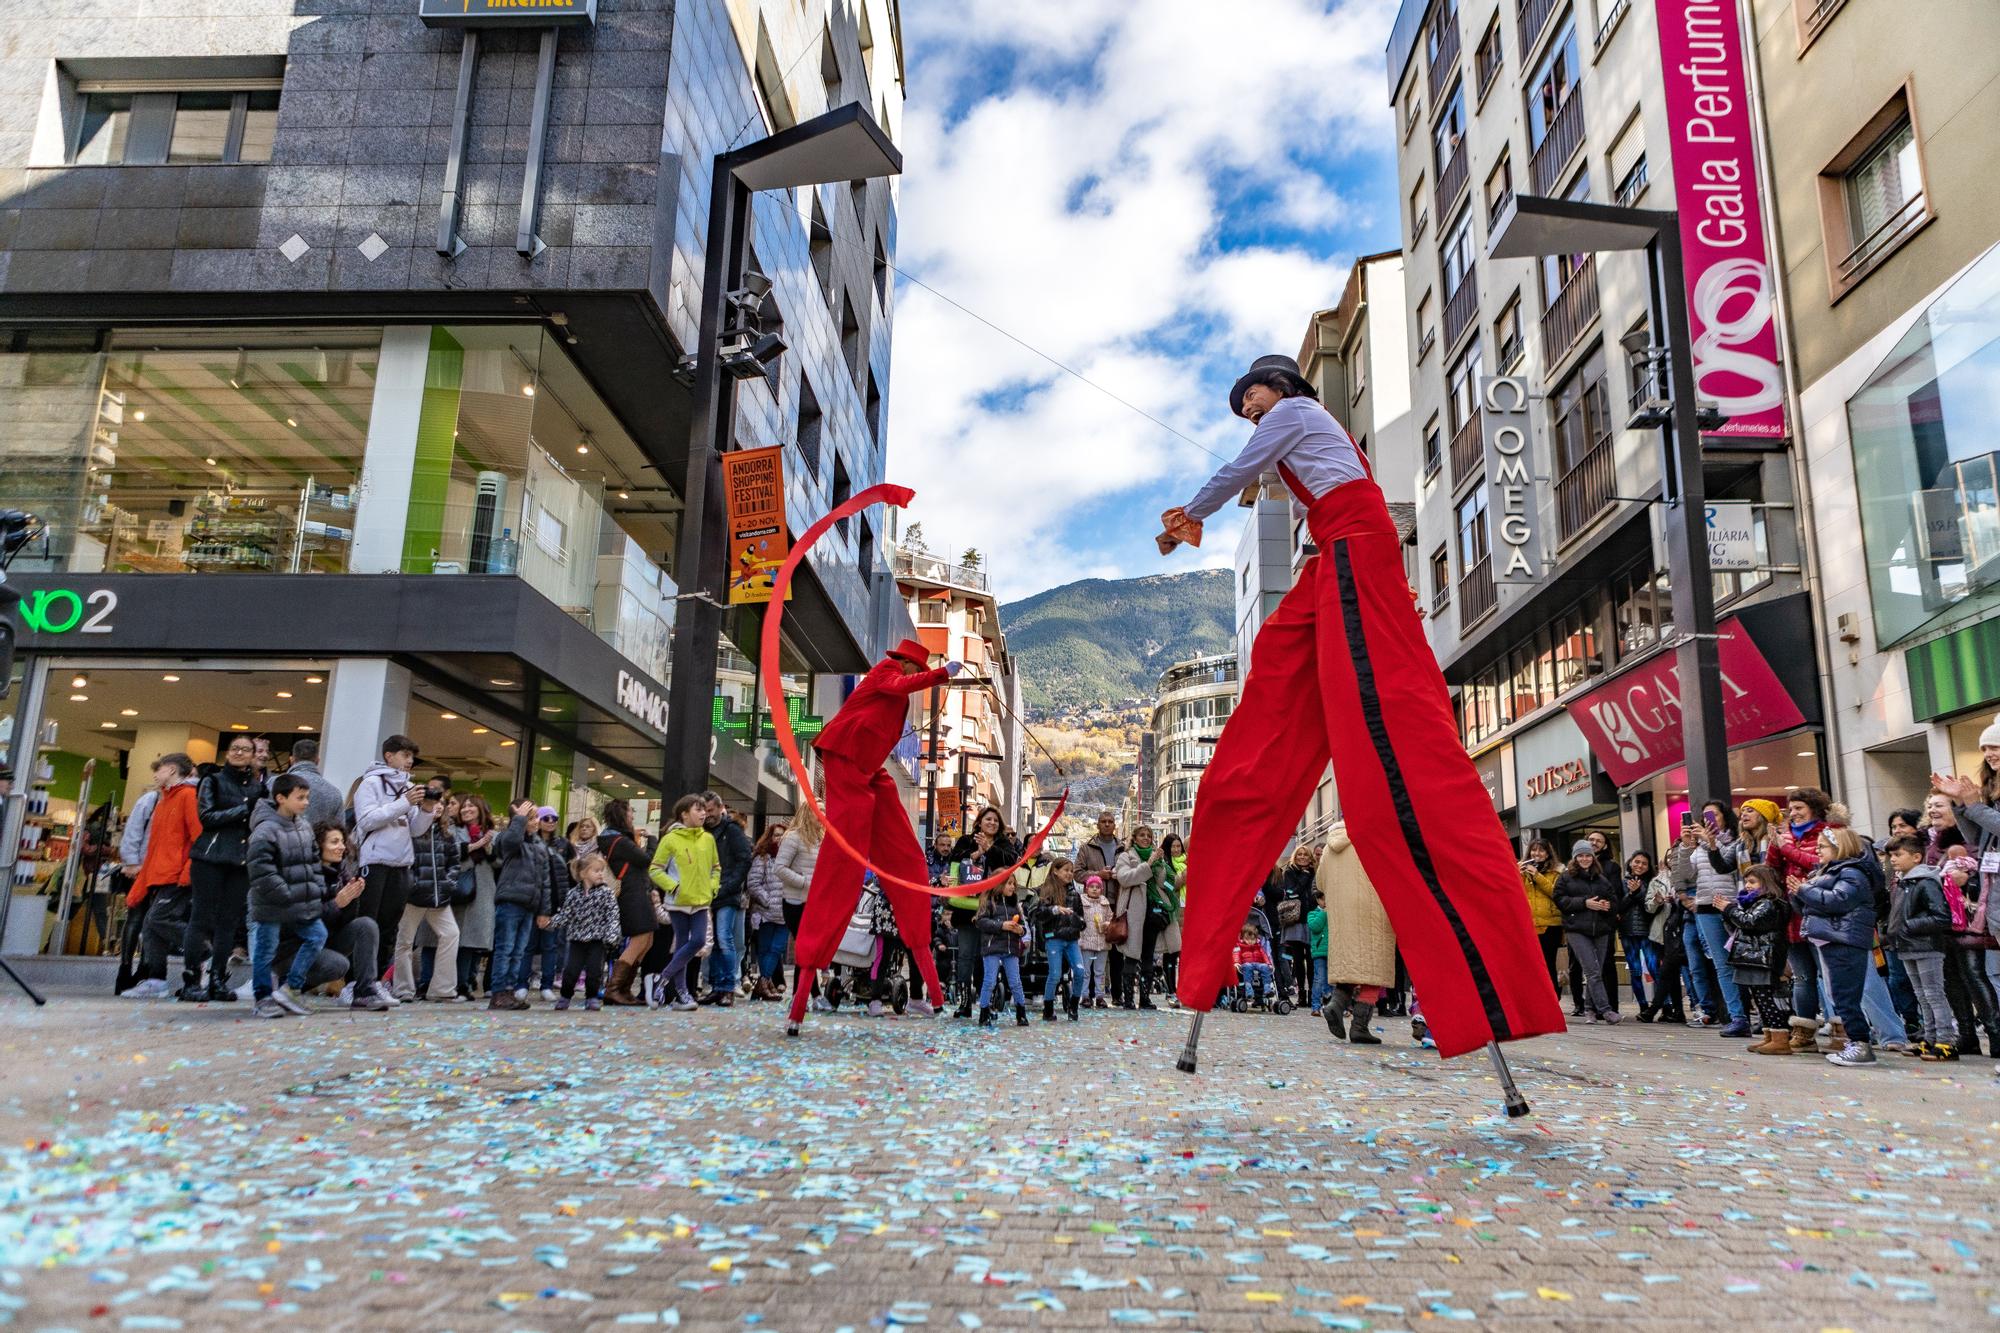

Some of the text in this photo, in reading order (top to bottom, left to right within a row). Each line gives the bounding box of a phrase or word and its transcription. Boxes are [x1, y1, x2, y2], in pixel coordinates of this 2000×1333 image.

[1679, 0, 1748, 248] Gala Perfum
[732, 458, 774, 476] ANDORRA
[733, 472, 774, 488] SHOPPING
[734, 484, 775, 502] FESTIVAL
[1494, 426, 1533, 576] OMEGA
[1627, 664, 1748, 733] GAA
